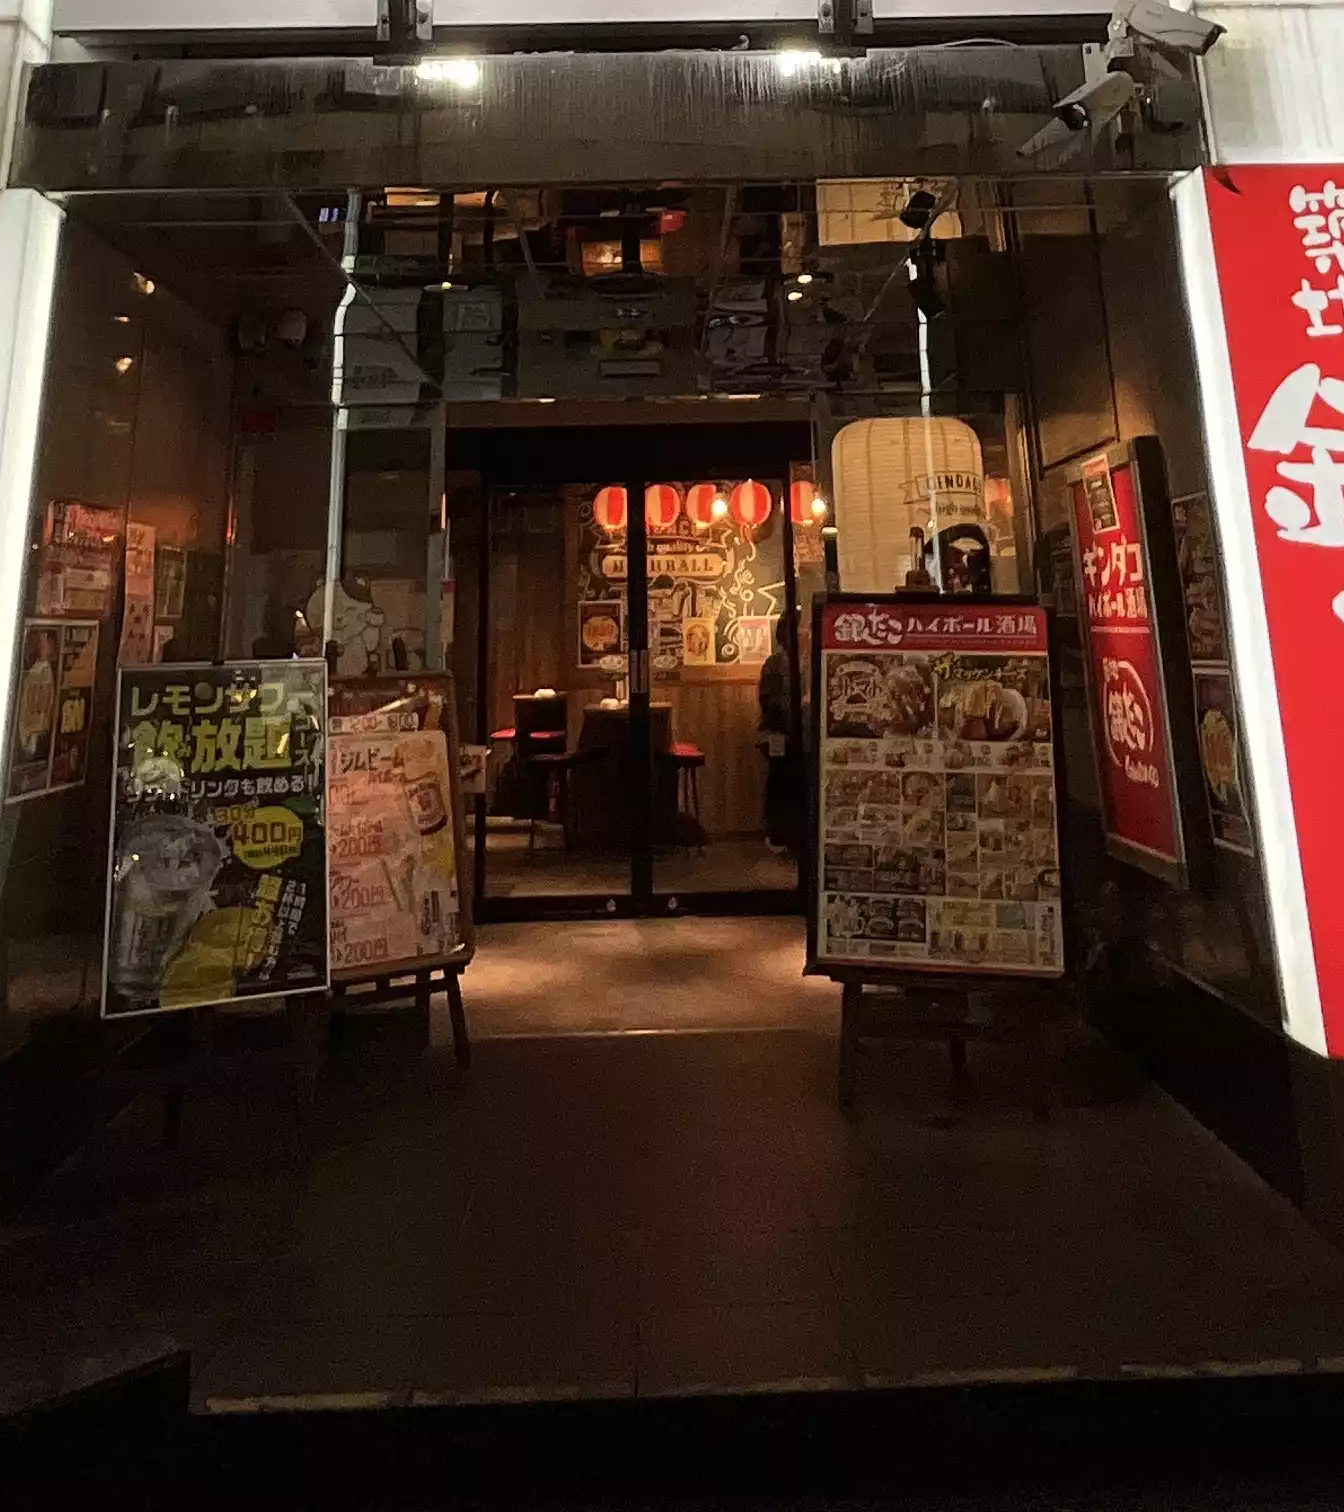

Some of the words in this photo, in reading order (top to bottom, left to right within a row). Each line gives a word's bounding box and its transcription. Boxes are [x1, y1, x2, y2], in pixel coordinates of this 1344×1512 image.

[1082, 535, 1144, 586] ギンダコ
[833, 609, 904, 646] 銀だこ
[906, 614, 1038, 636] ハイボール酒場
[232, 821, 303, 846] 400円
